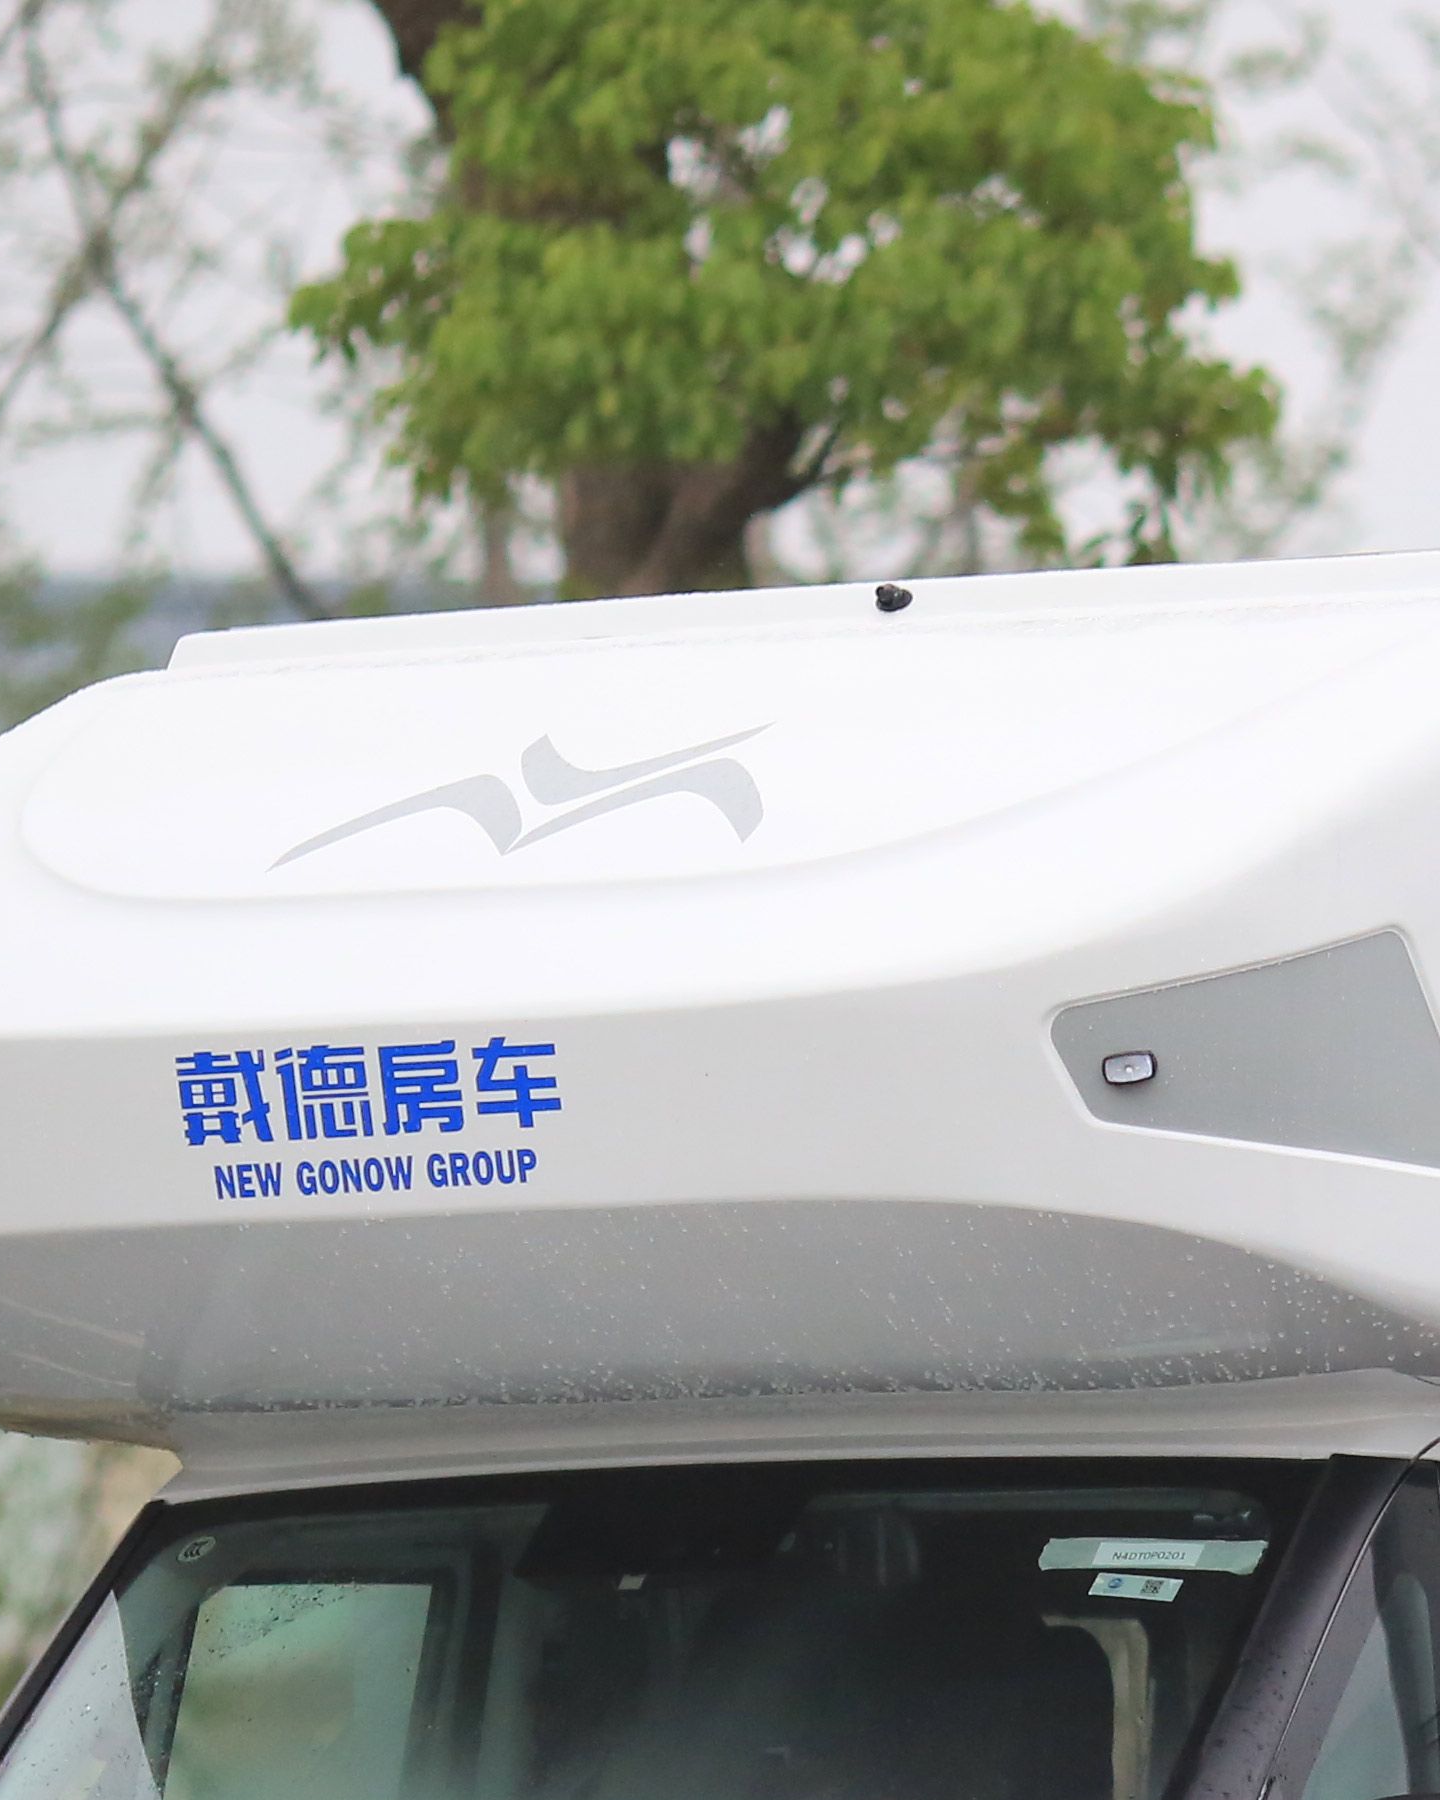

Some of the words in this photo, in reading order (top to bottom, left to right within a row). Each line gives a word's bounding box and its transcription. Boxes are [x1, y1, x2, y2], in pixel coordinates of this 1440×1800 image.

[175, 1037, 562, 1146] 戴德房车
[215, 1164, 282, 1199] NEW
[297, 1156, 412, 1196] GONOW
[427, 1149, 537, 1188] GROUP
